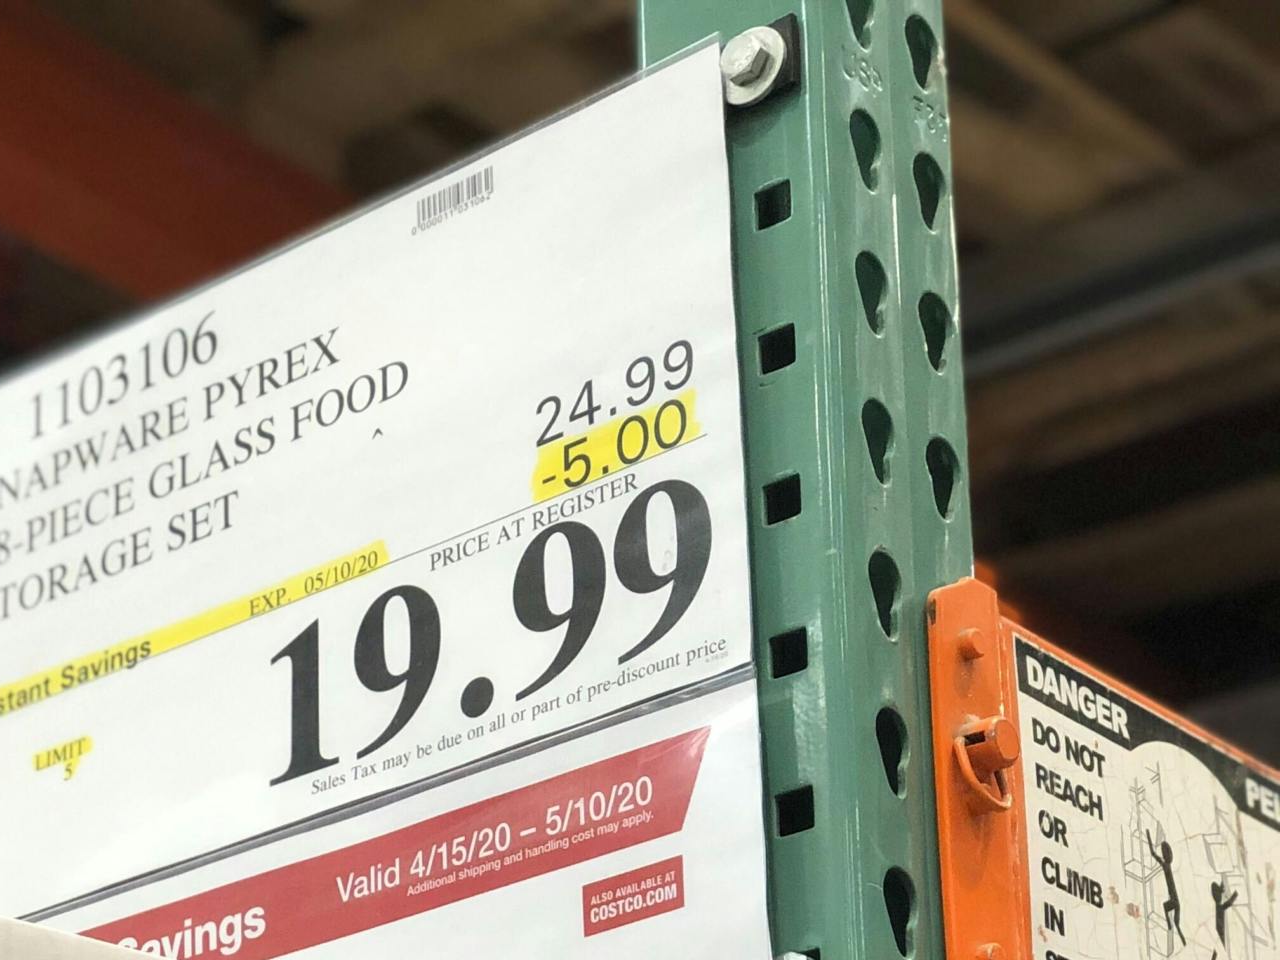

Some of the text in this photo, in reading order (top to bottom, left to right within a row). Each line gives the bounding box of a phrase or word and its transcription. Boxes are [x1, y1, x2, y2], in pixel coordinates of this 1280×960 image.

[31, 310, 219, 440] 1103106
[203, 327, 341, 423] PYREX
[535, 340, 694, 448] 24.99
[148, 417, 276, 500] GLASS
[290, 360, 410, 442] FOOD
[542, 399, 687, 488] -5.00
[167, 490, 241, 553] SET
[428, 473, 639, 572] PRICE AT REGISTER
[248, 550, 380, 617] EXP. 05/10/20
[61, 640, 151, 690] Savings
[269, 479, 712, 787] 19.99
[311, 774, 346, 796] Sales
[351, 759, 377, 782] Tax
[382, 751, 411, 776] may
[416, 740, 433, 760] be
[437, 730, 462, 752] due
[467, 723, 485, 741] on
[489, 712, 506, 734] all
[510, 708, 526, 725] or
[531, 696, 561, 721] part
[566, 687, 583, 707] of
[586, 652, 680, 707] pre-discount
[686, 637, 727, 668] price
[1026, 654, 1131, 741] DANGER
[35, 737, 86, 771] LIMIT
[63, 762, 73, 781] 5
[1031, 717, 1106, 779] DO NOT
[1035, 762, 1104, 821] REACH
[336, 859, 400, 902] Valid
[409, 822, 511, 878] 4/15/20
[545, 776, 653, 835] 5/10/20
[407, 811, 654, 897] Additional shipping and handling cost may apply.
[1038, 808, 1068, 848] OR
[590, 871, 676, 906] ALSO AVAILABLE AT
[590, 883, 678, 924] COSTCO.COM
[1040, 856, 1104, 910] CLIMB
[117, 906, 266, 960] vings
[1044, 902, 1066, 937] IN
